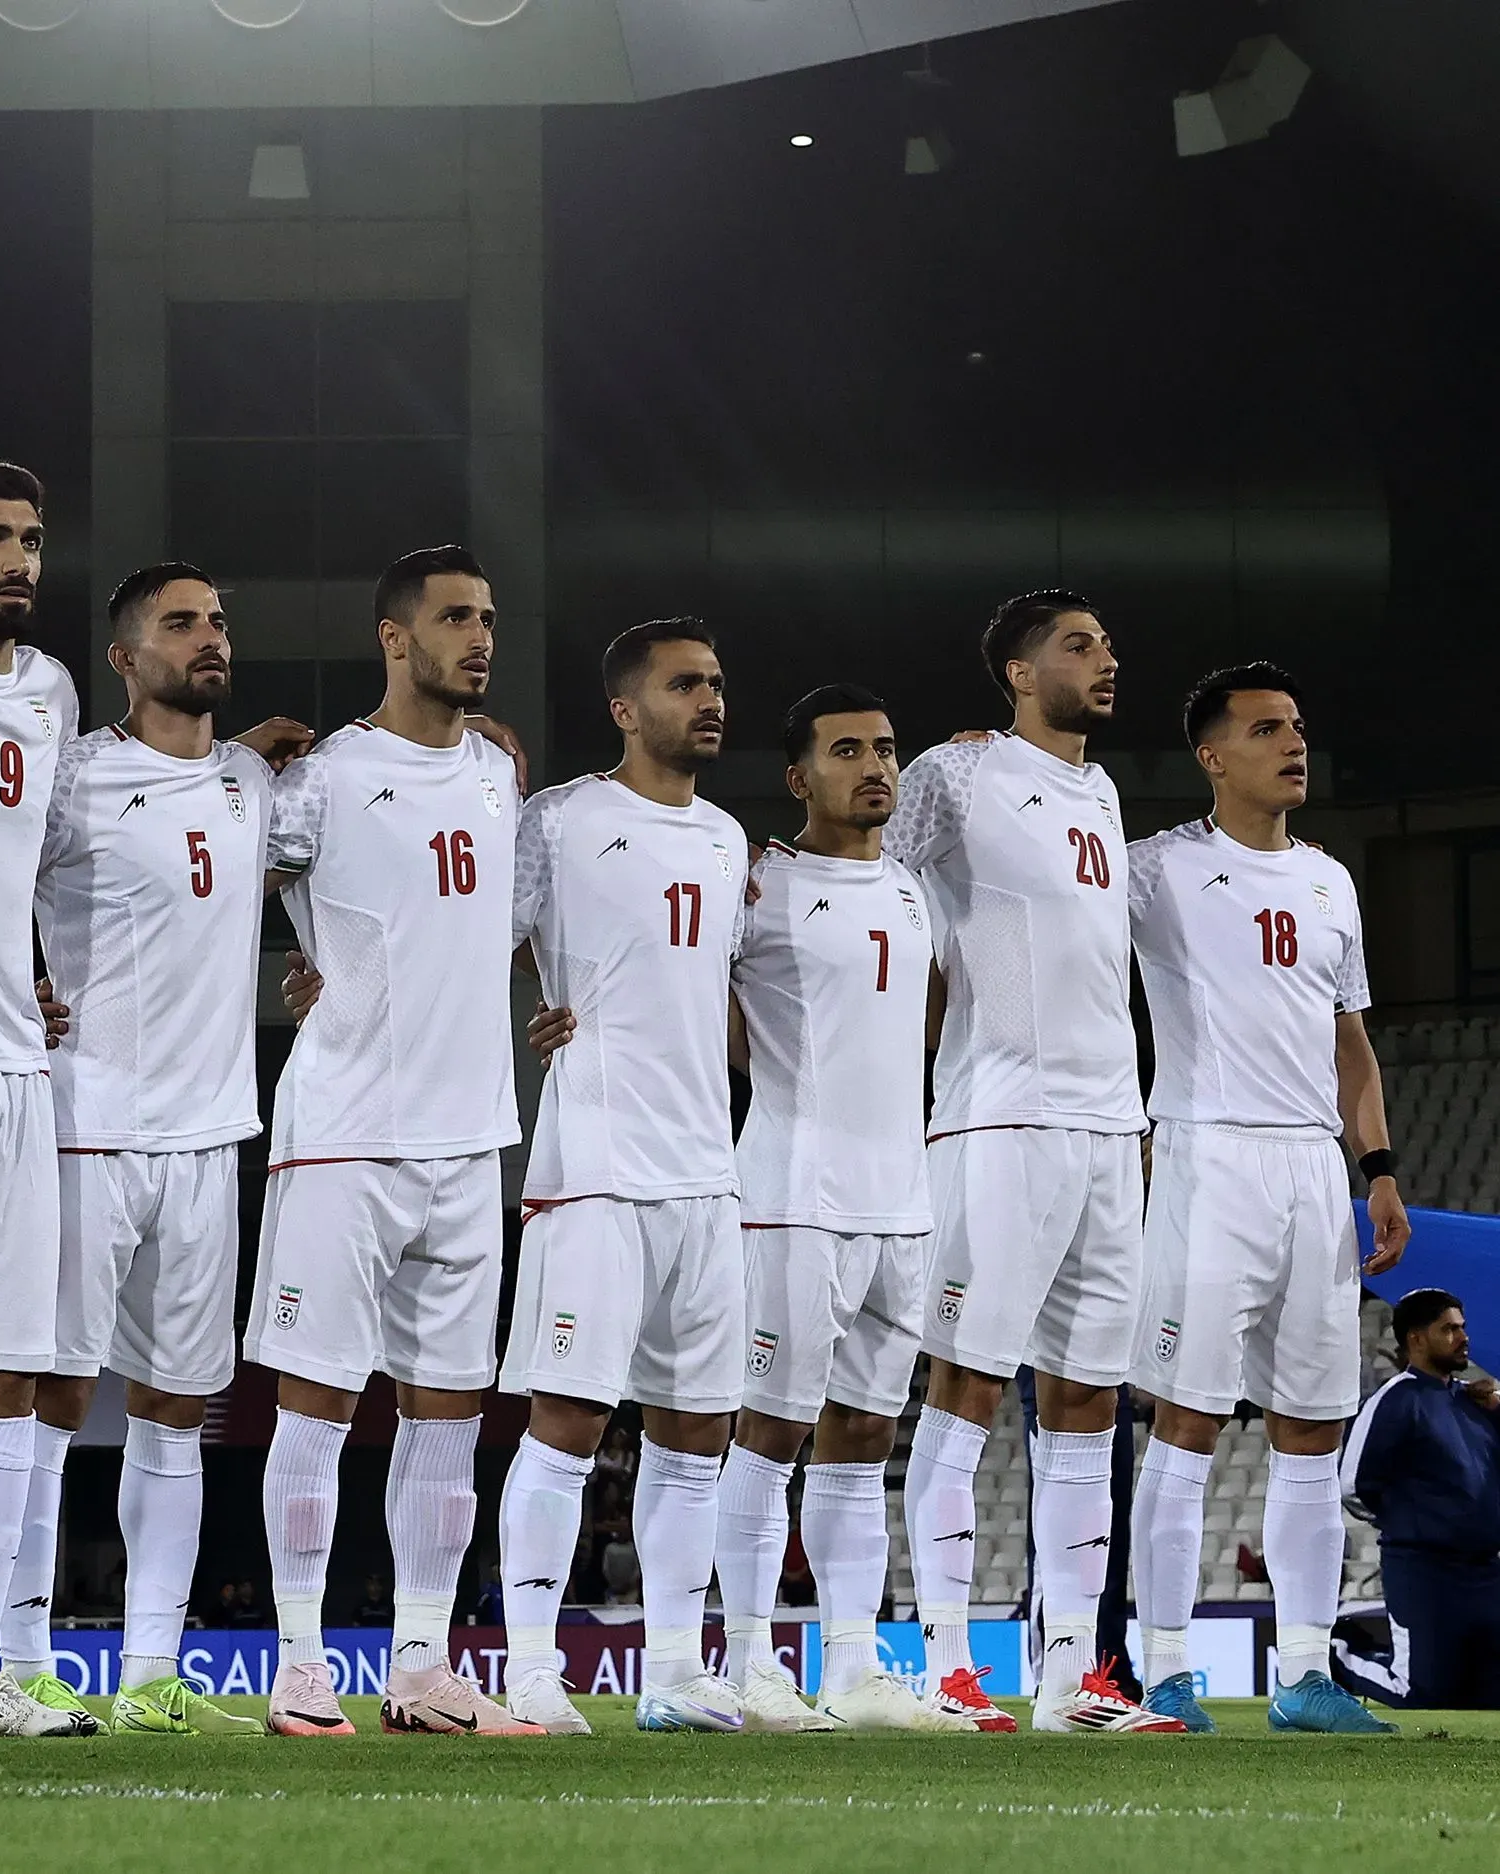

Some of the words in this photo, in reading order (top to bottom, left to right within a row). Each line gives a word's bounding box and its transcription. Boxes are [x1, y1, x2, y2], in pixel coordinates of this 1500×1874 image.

[187, 831, 212, 898] 5
[429, 830, 476, 896] 16
[1067, 827, 1110, 889] 20
[664, 883, 701, 947] 17
[1254, 908, 1298, 968] 18
[869, 930, 888, 992] 7
[182, 1647, 387, 1696] SAION
